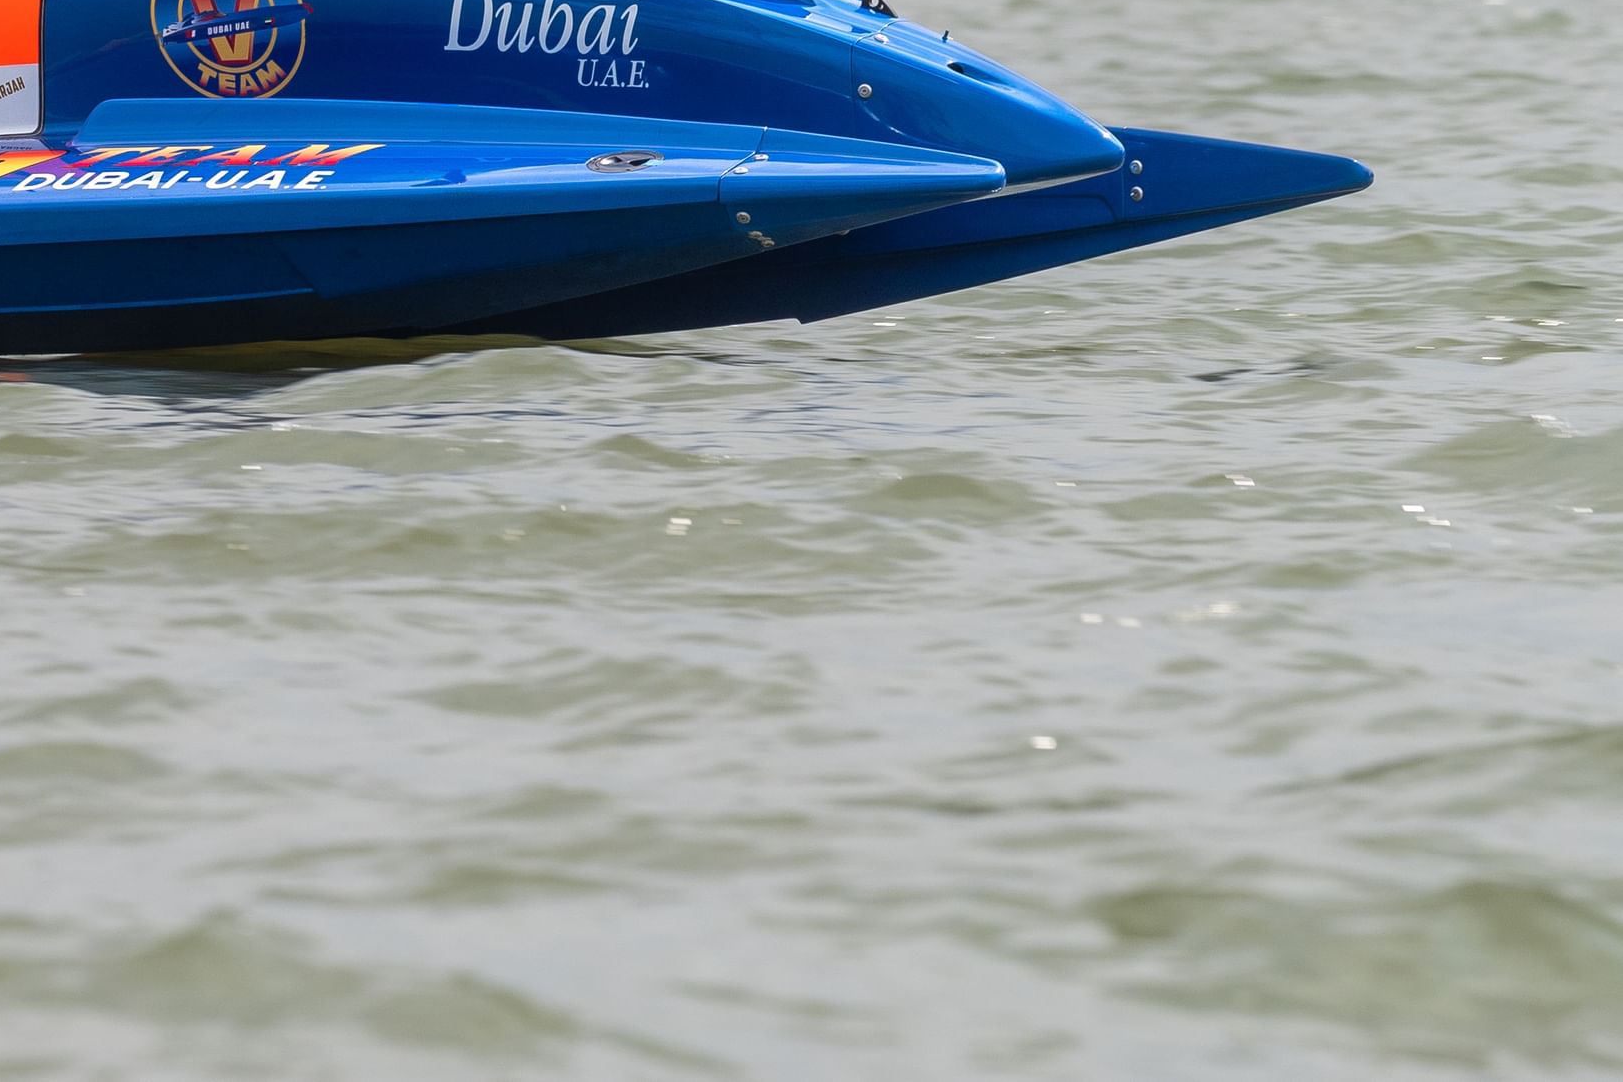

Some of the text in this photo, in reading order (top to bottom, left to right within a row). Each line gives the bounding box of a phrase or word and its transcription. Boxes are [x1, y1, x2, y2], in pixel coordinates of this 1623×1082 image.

[207, 21, 250, 36] DUBAI UAE
[197, 59, 287, 96] TEAM
[577, 58, 650, 88] U.A.E.
[70, 144, 386, 168] TEAM
